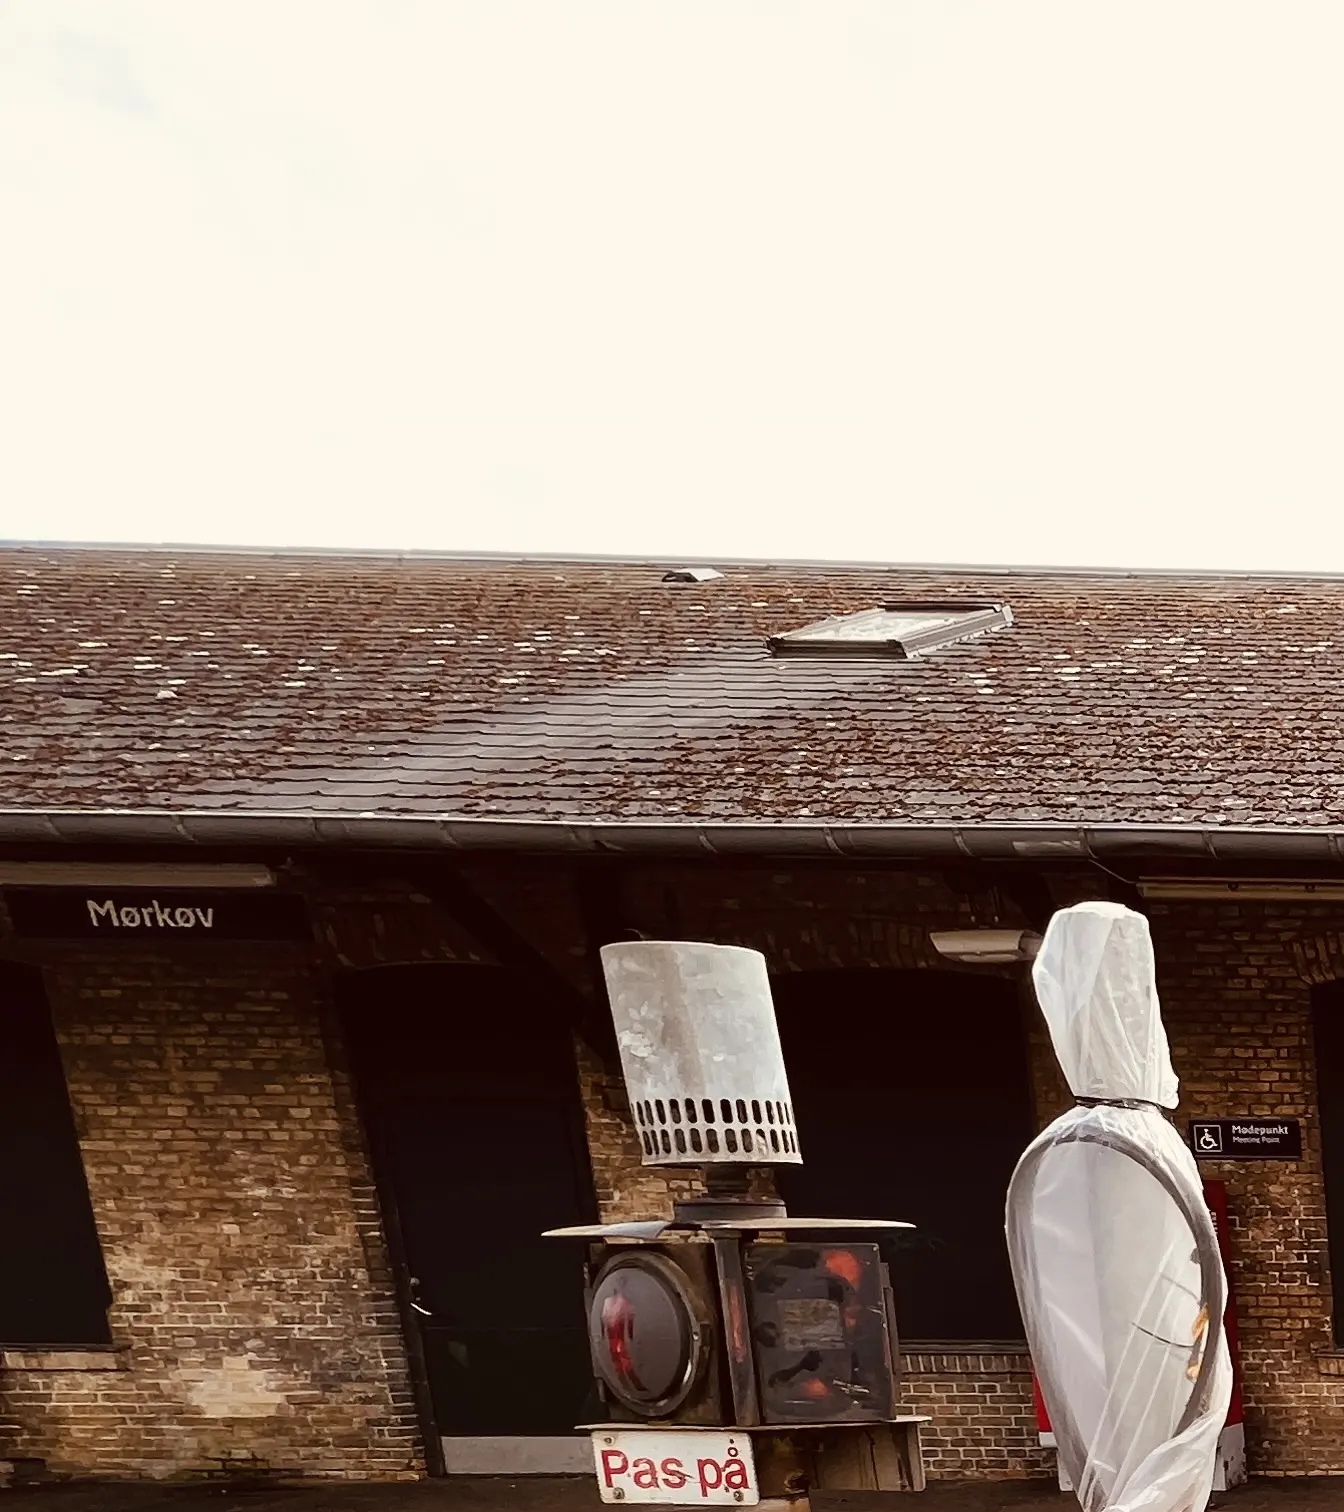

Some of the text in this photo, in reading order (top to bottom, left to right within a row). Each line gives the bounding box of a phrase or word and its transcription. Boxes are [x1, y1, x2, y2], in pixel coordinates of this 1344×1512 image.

[86, 899, 214, 928] Mørkøv
[1231, 1124, 1289, 1136] Mødepunkt
[600, 1446, 751, 1498] Pas på
